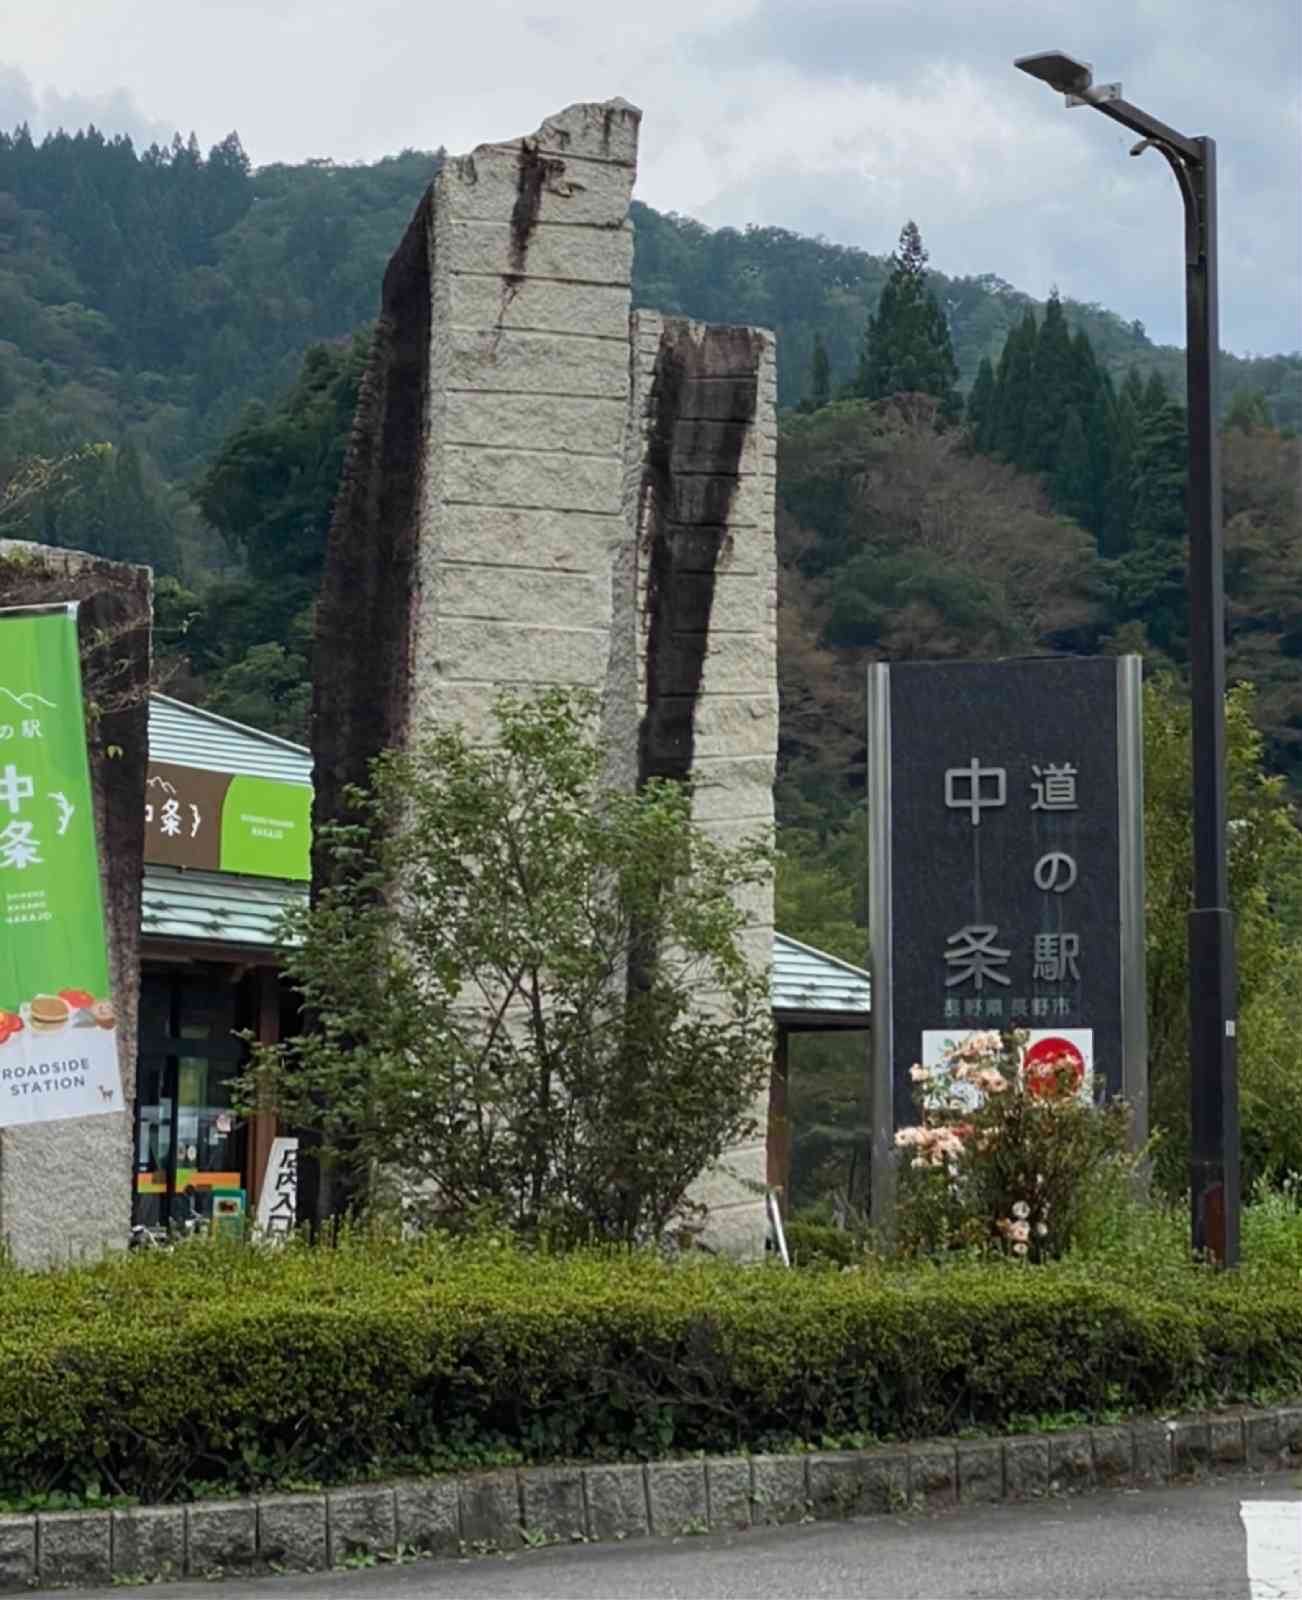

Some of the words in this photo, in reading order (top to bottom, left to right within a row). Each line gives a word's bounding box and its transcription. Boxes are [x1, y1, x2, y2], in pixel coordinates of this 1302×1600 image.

[945, 757, 1011, 990] 中条
[1030, 762, 1081, 981] 道の駅
[2, 1058, 89, 1080] ROADSIDE
[10, 1076, 85, 1096] STATION
